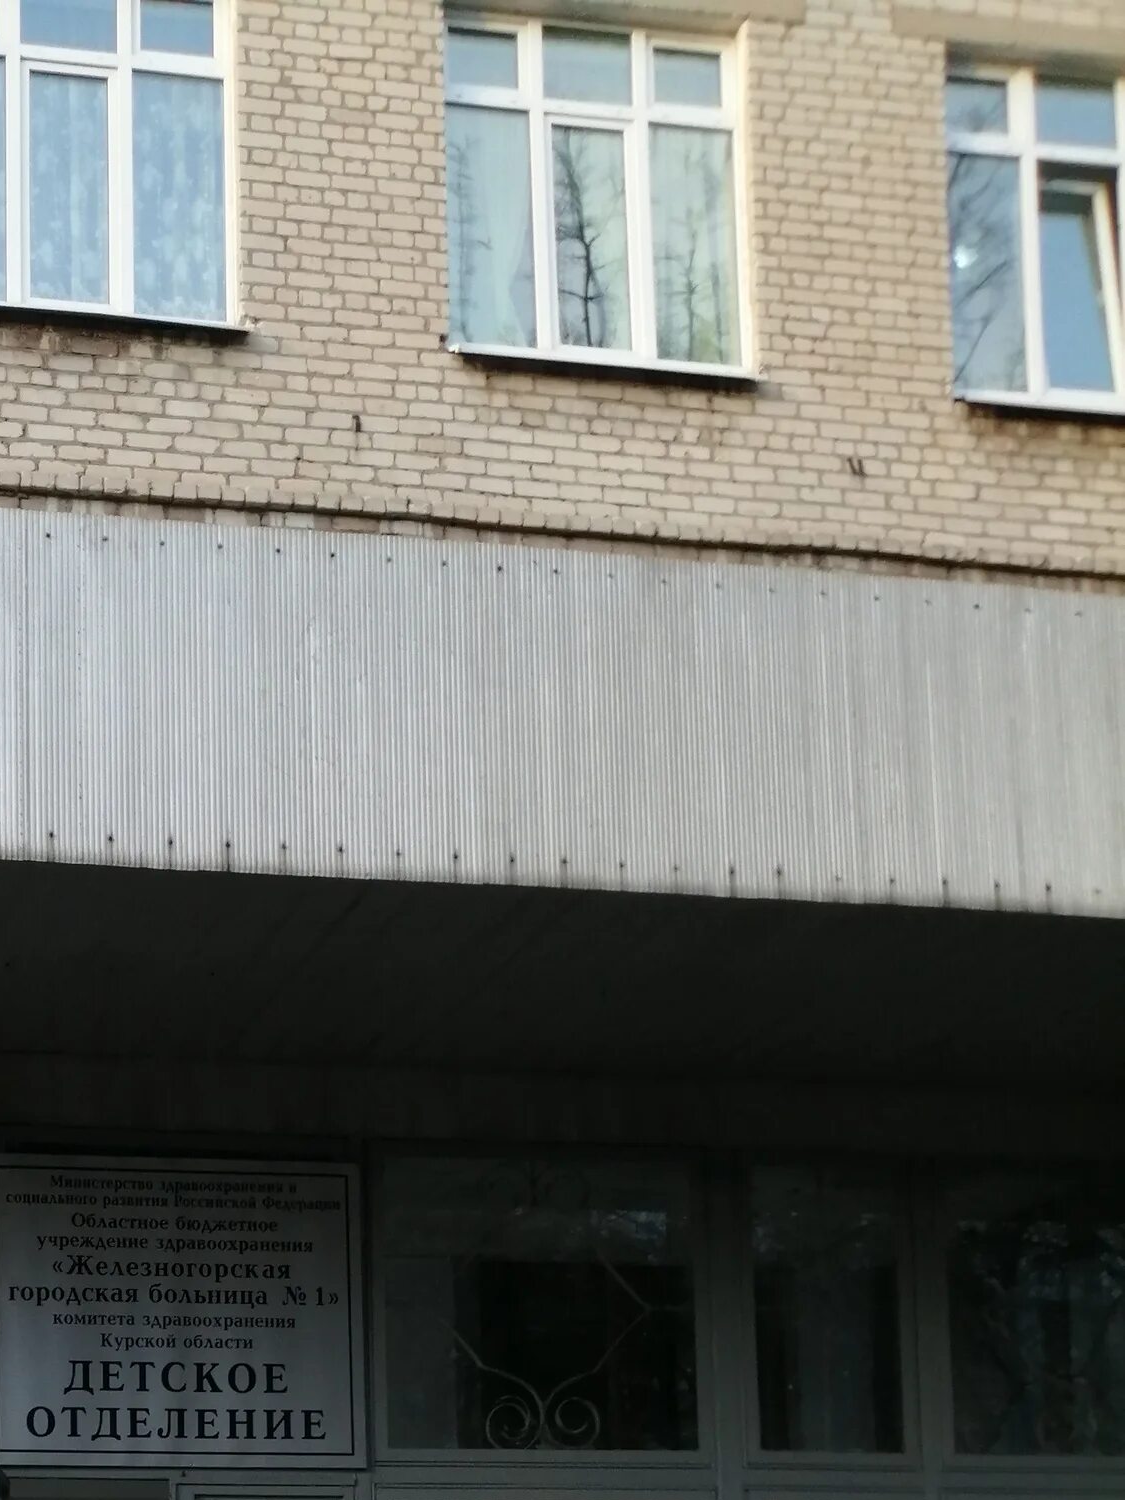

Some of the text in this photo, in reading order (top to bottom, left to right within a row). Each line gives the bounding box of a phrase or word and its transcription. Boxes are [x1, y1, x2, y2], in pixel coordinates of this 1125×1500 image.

[50, 1174, 153, 1192] Министерство
[6, 1192, 97, 1206] социального
[103, 1195, 168, 1209] развития
[71, 1212, 278, 1234] Областное бюджетное
[36, 1234, 313, 1254] учреждение здравоохранения
[52, 1255, 291, 1282] «Железногорская
[8, 1285, 138, 1306] городская
[149, 1284, 268, 1309] больница
[52, 1314, 296, 1331] комитета здравоохранения
[100, 1332, 253, 1351] Курской области
[63, 1360, 288, 1396] ДЕТСКОЕ
[26, 1406, 326, 1441] ОТДЕЛЕНИЕ
